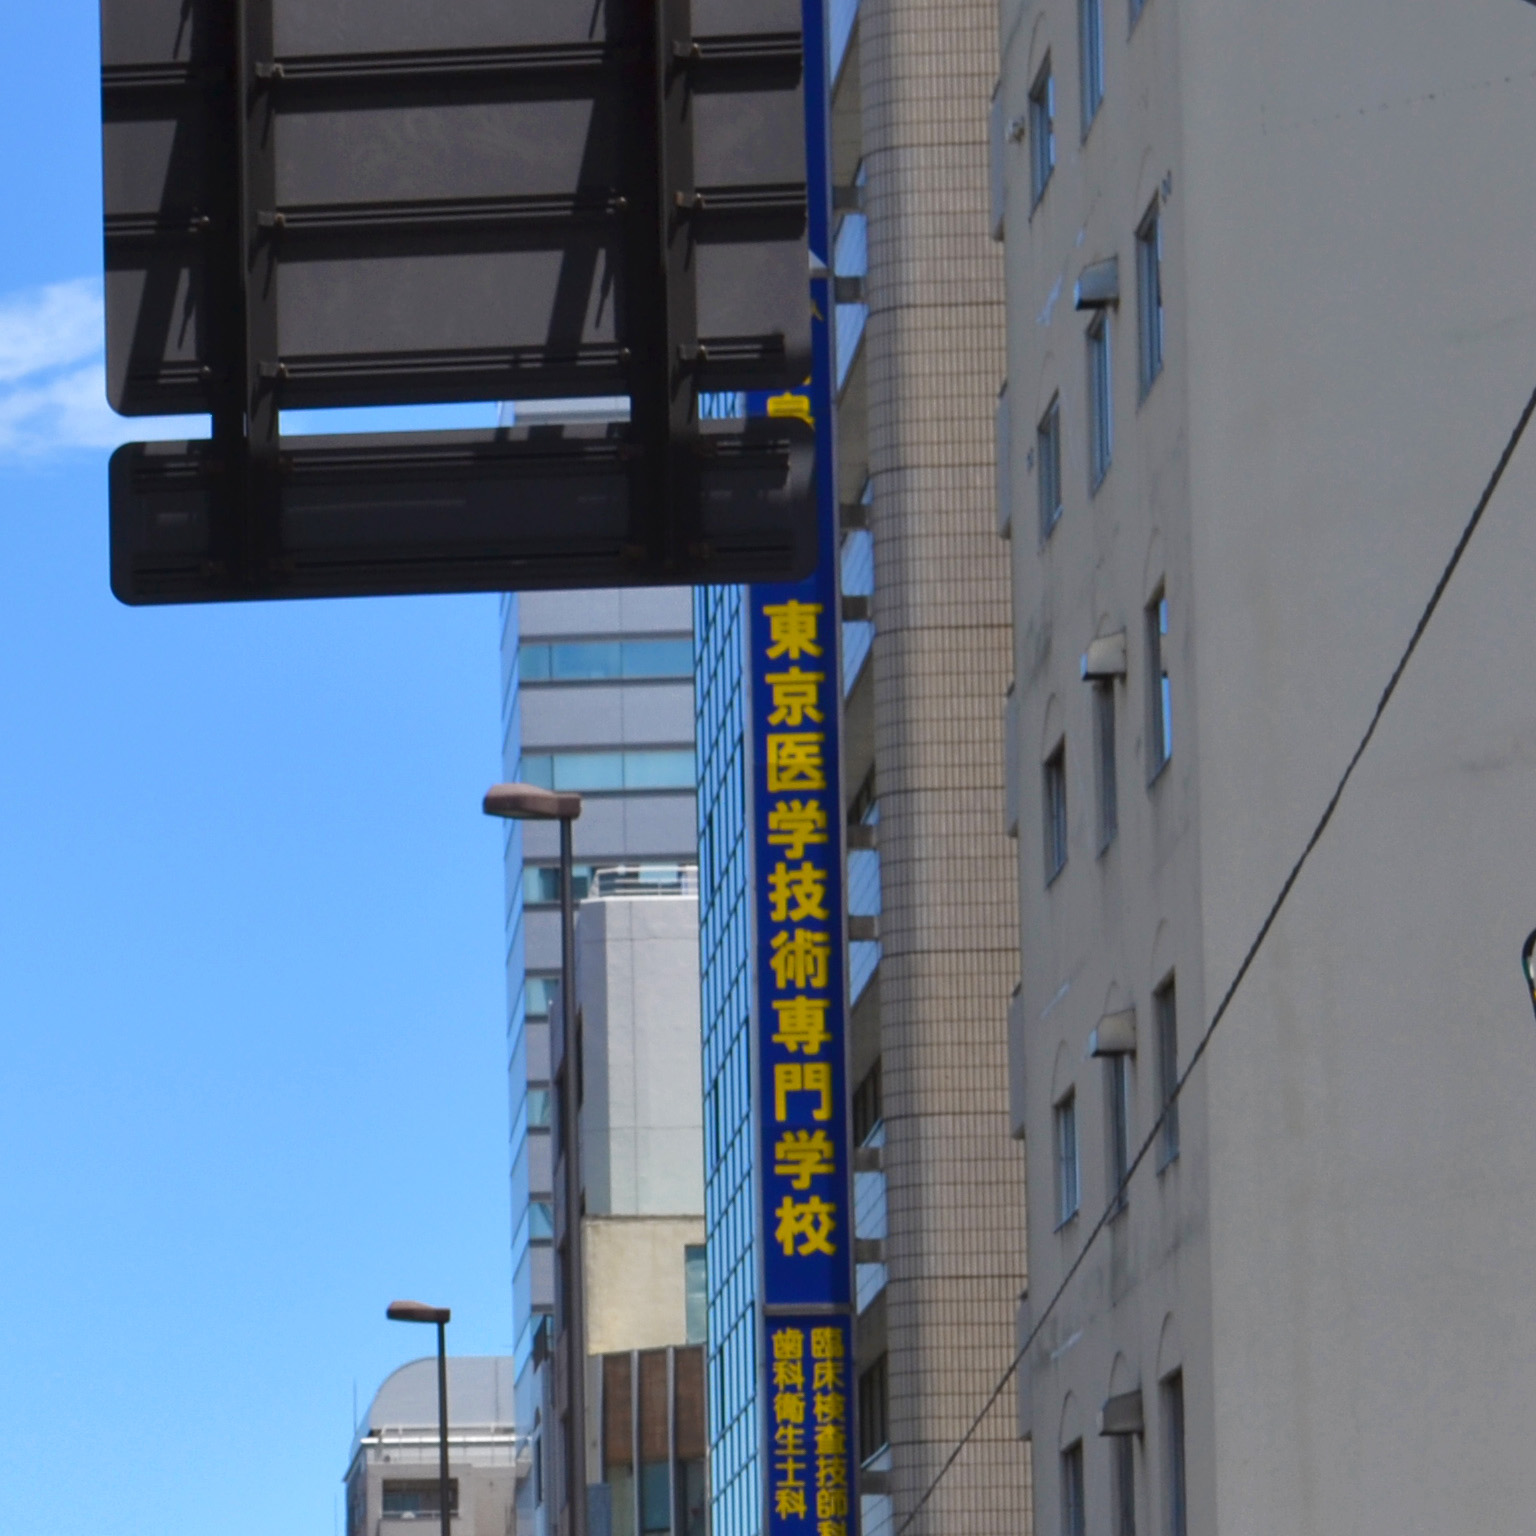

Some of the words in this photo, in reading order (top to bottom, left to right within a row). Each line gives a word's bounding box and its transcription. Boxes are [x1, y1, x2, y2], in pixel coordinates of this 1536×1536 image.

[762, 598, 837, 1257] 東京医学技術専門学校
[771, 1327, 807, 1520] 歯科衛生士科
